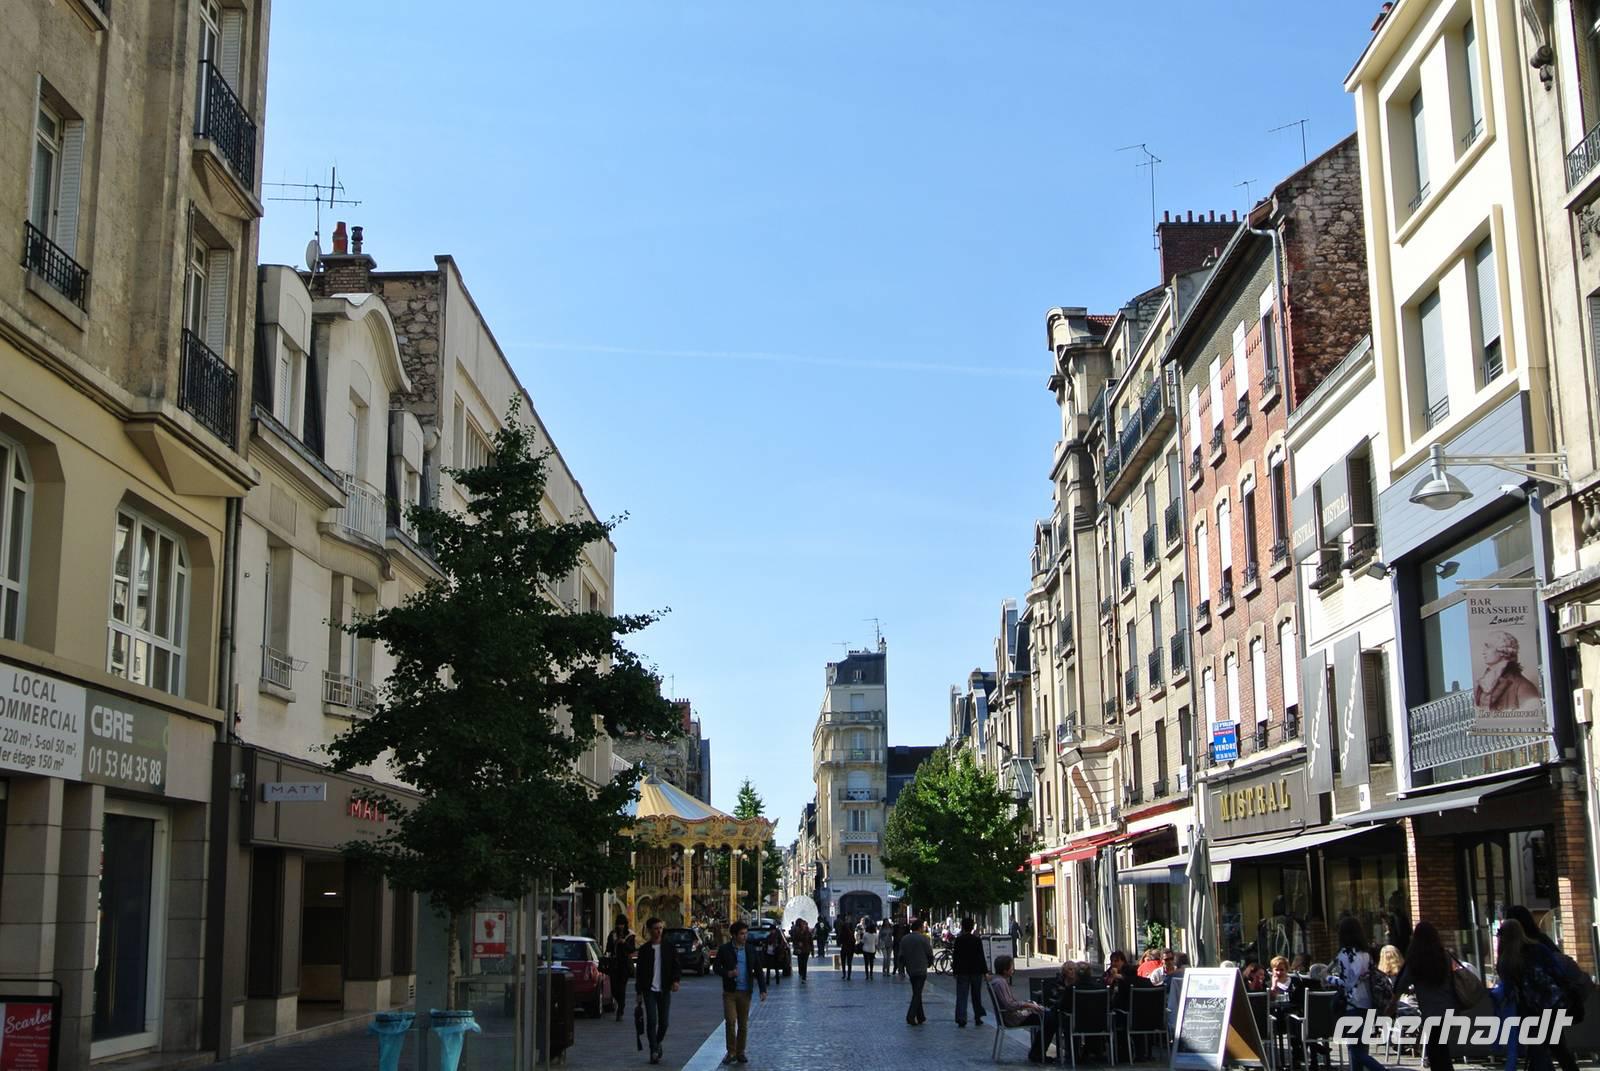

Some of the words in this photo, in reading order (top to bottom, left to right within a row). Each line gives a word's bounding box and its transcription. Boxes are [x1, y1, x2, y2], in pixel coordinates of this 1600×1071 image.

[1470, 598, 1492, 606] BAR
[1471, 606, 1529, 615] BRASSERIE
[1489, 615, 1525, 625] Lounge
[12, 673, 57, 703] LOCAL
[91, 704, 134, 744] CBRE
[3, 727, 19, 744] 220
[35, 734, 54, 752] S-sol
[55, 739, 65, 753] 50
[1215, 742, 1236, 752] VENDRE
[1222, 736, 1228, 744] A
[12, 748, 36, 769] étage
[38, 754, 52, 769] 150
[88, 745, 102, 774] 01
[105, 749, 119, 778] 53
[120, 753, 133, 780] 64
[134, 755, 148, 783] 35
[149, 759, 162, 786] 88
[271, 785, 322, 794] MATY
[1220, 778, 1291, 821] MISTRAL
